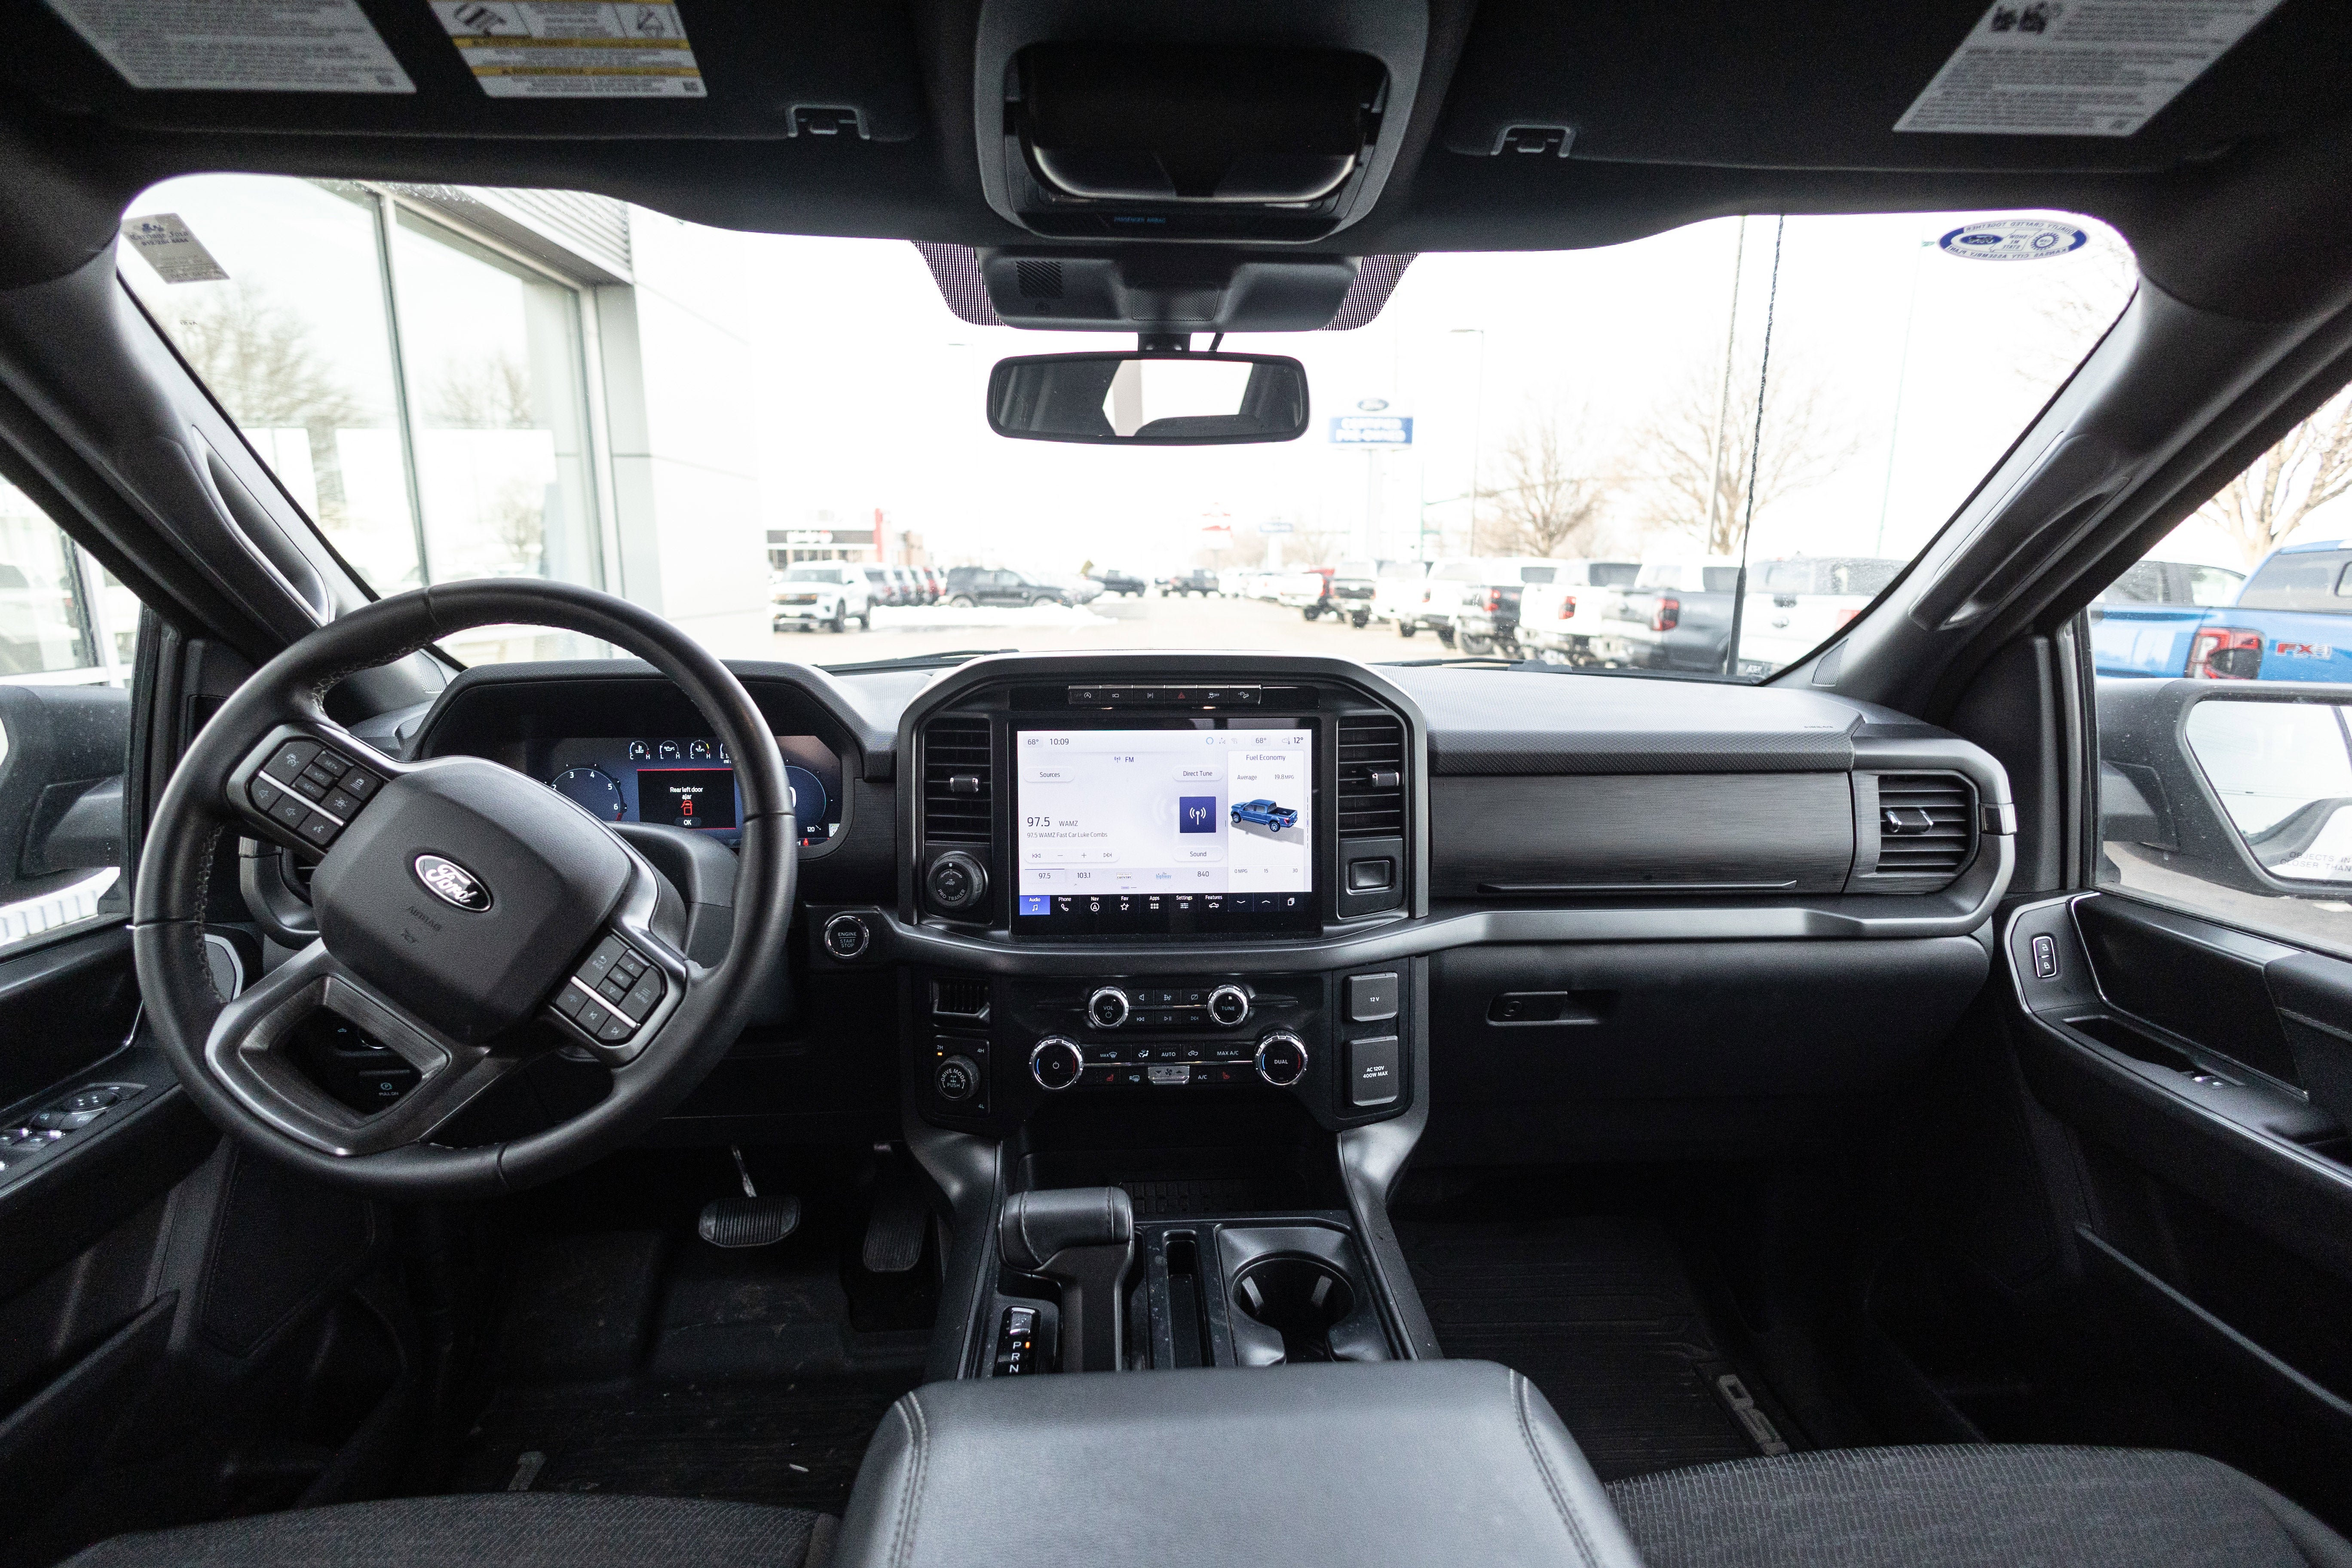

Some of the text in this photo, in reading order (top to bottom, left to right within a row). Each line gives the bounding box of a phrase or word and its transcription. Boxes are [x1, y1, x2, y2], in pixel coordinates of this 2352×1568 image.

[2275, 641, 2332, 657] FX4
[1027, 817, 1050, 827] 97.5
[2289, 851, 2335, 862] OBJECTS
[2280, 858, 2352, 872] CLOSER THAN
[426, 864, 478, 902] Ford
[938, 889, 966, 900] PRO TRAILER
[635, 992, 648, 1003] MENU
[941, 1069, 965, 1082] DRIVE MODE
[1009, 1364, 1019, 1373] N
